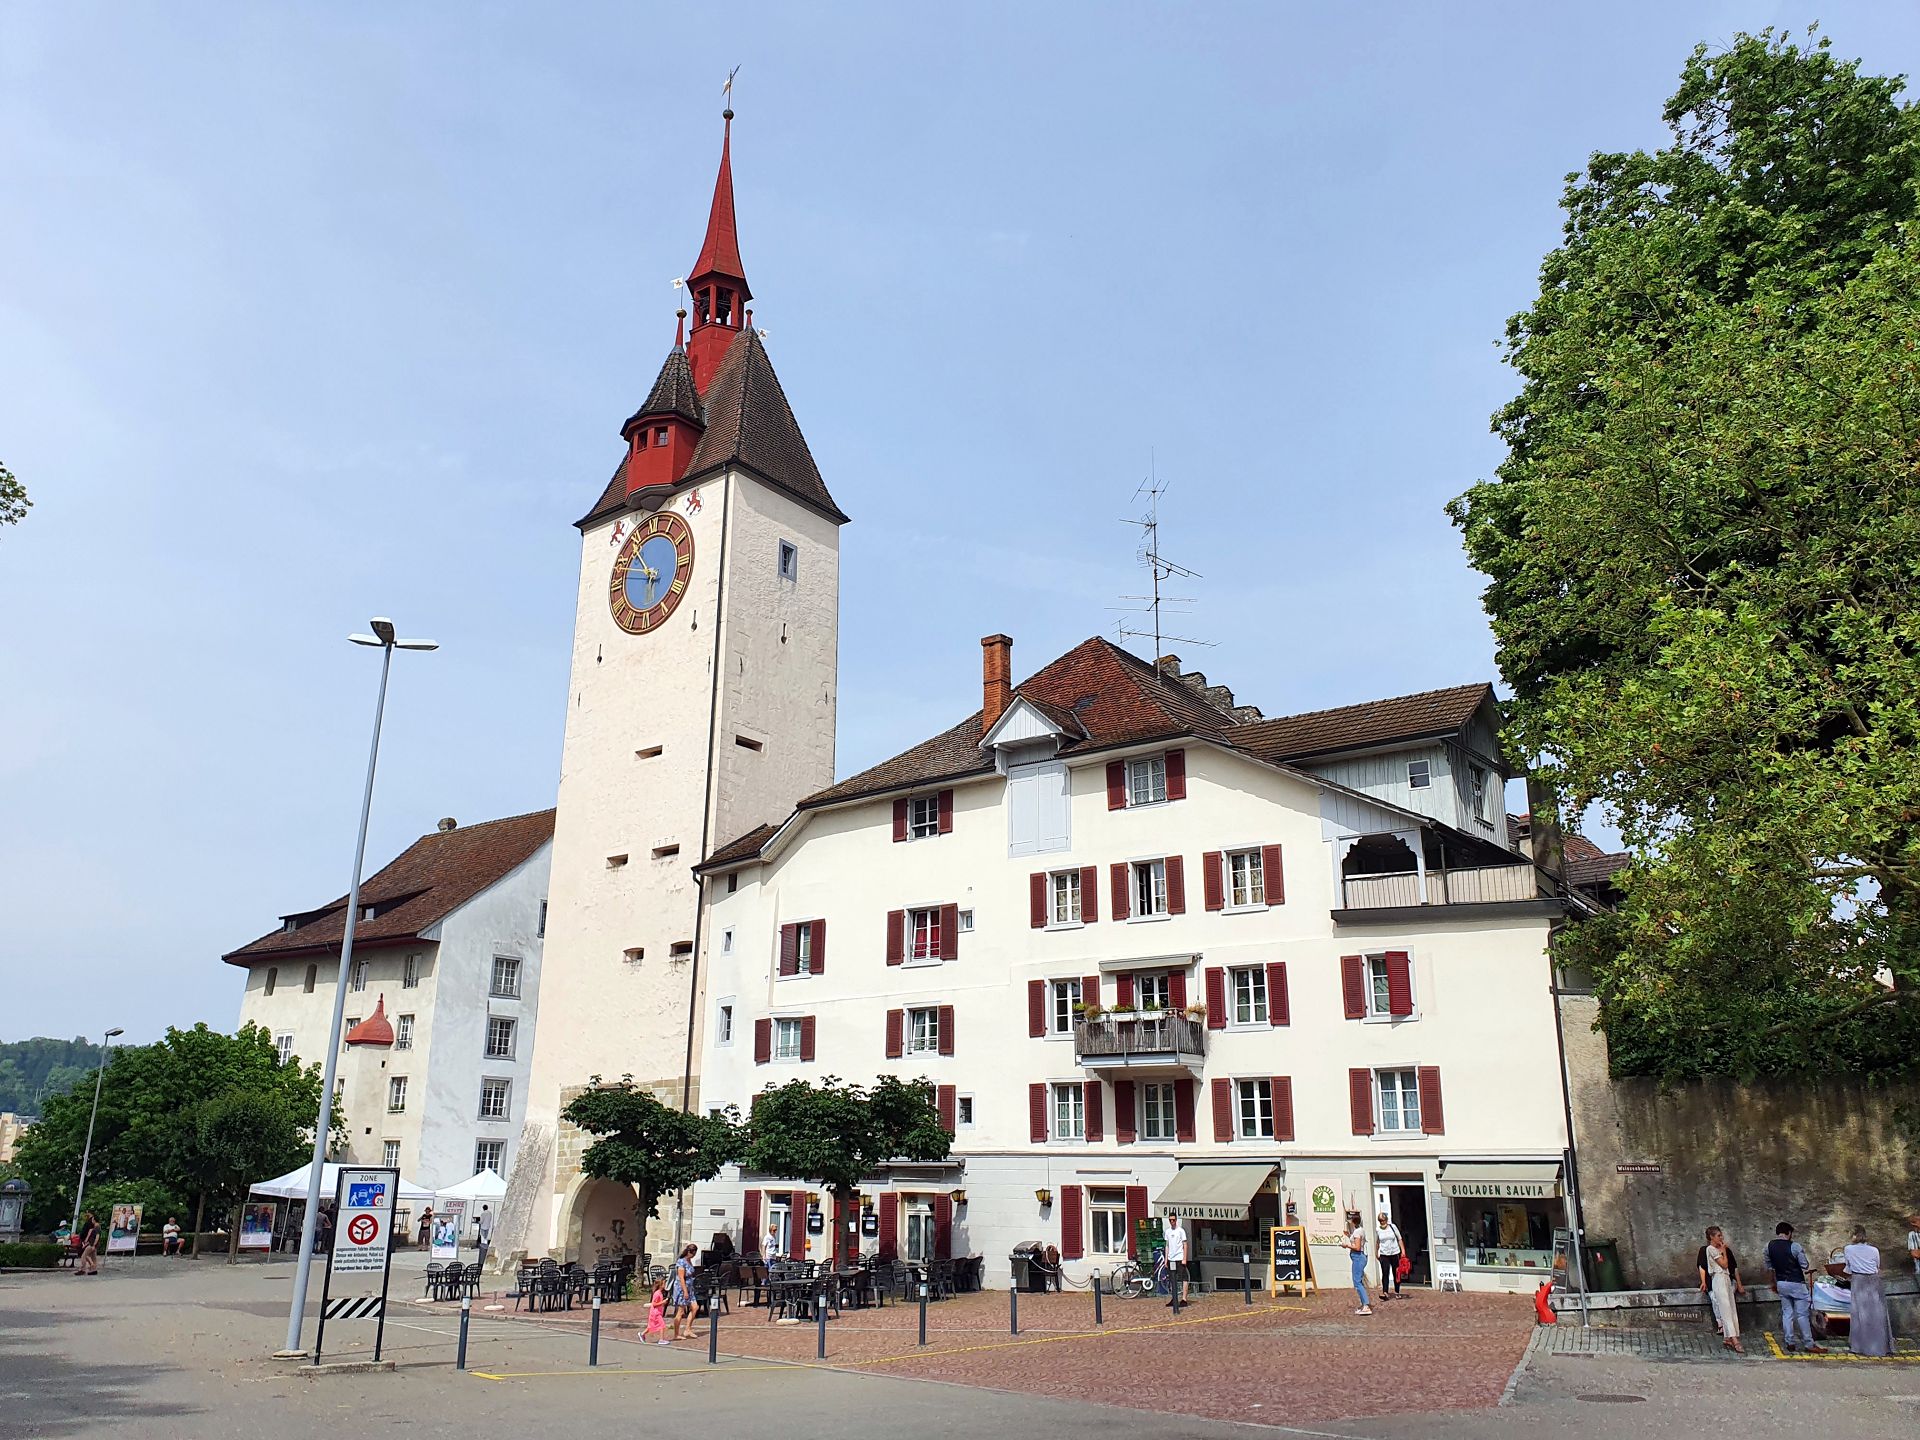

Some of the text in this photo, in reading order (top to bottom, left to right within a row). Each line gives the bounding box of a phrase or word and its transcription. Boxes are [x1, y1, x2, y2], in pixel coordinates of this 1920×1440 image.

[678, 554, 689, 566] III
[671, 579, 684, 595] IIII
[1452, 1185, 1544, 1196] BIOLADEN SALVIA
[1163, 1206, 1240, 1218] BIOLADEN SALVIA
[1278, 1239, 1296, 1247] HEUTE
